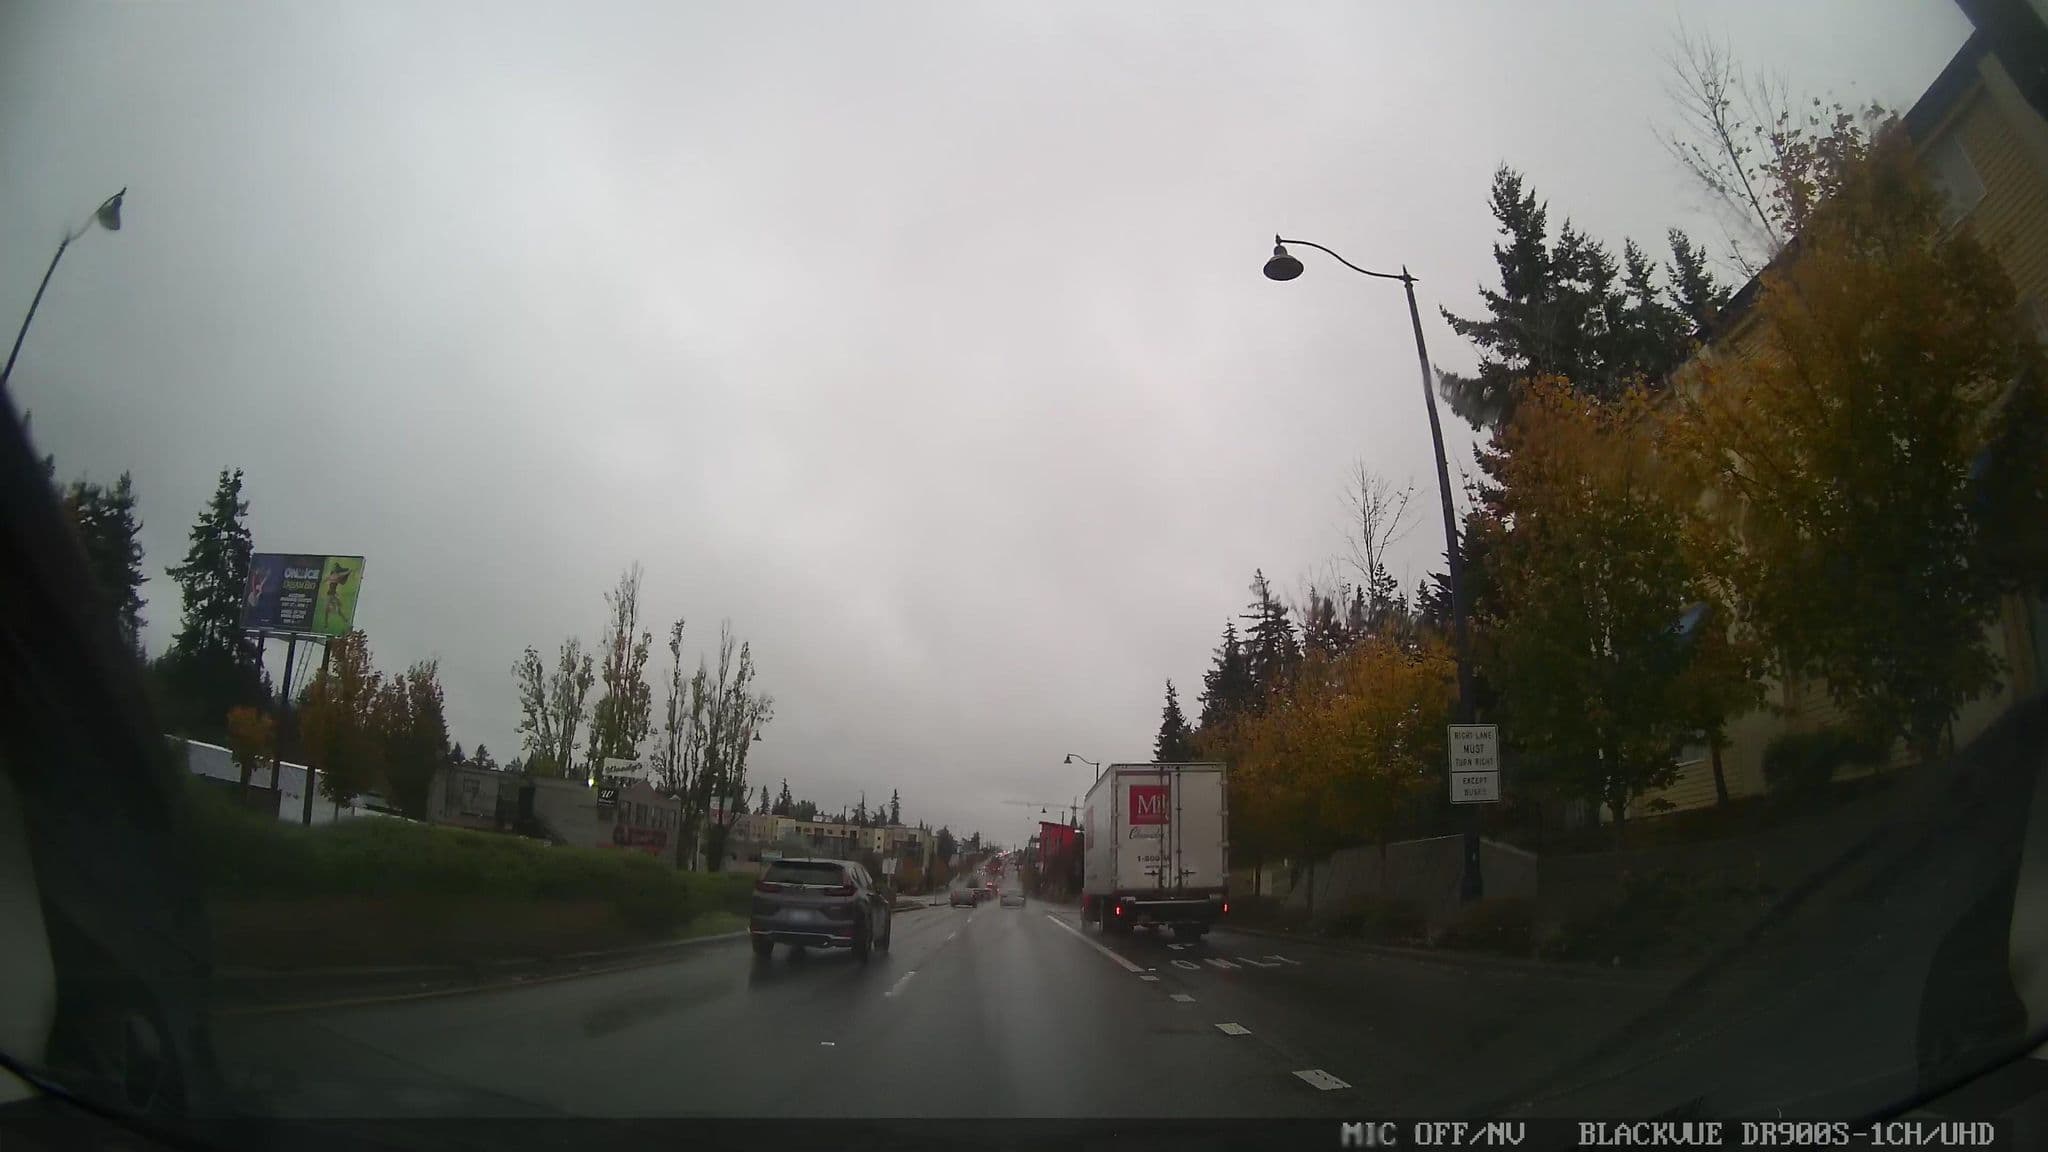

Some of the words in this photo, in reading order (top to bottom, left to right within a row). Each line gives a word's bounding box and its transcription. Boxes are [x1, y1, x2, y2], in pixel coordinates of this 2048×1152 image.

[1454, 731, 1473, 740] RIGHT
[1475, 731, 1492, 740] LANE
[1463, 744, 1485, 753] MUST
[1455, 758, 1472, 767] TURN
[1475, 757, 1494, 766] RIGHT
[1462, 777, 1487, 785] EXCEPT
